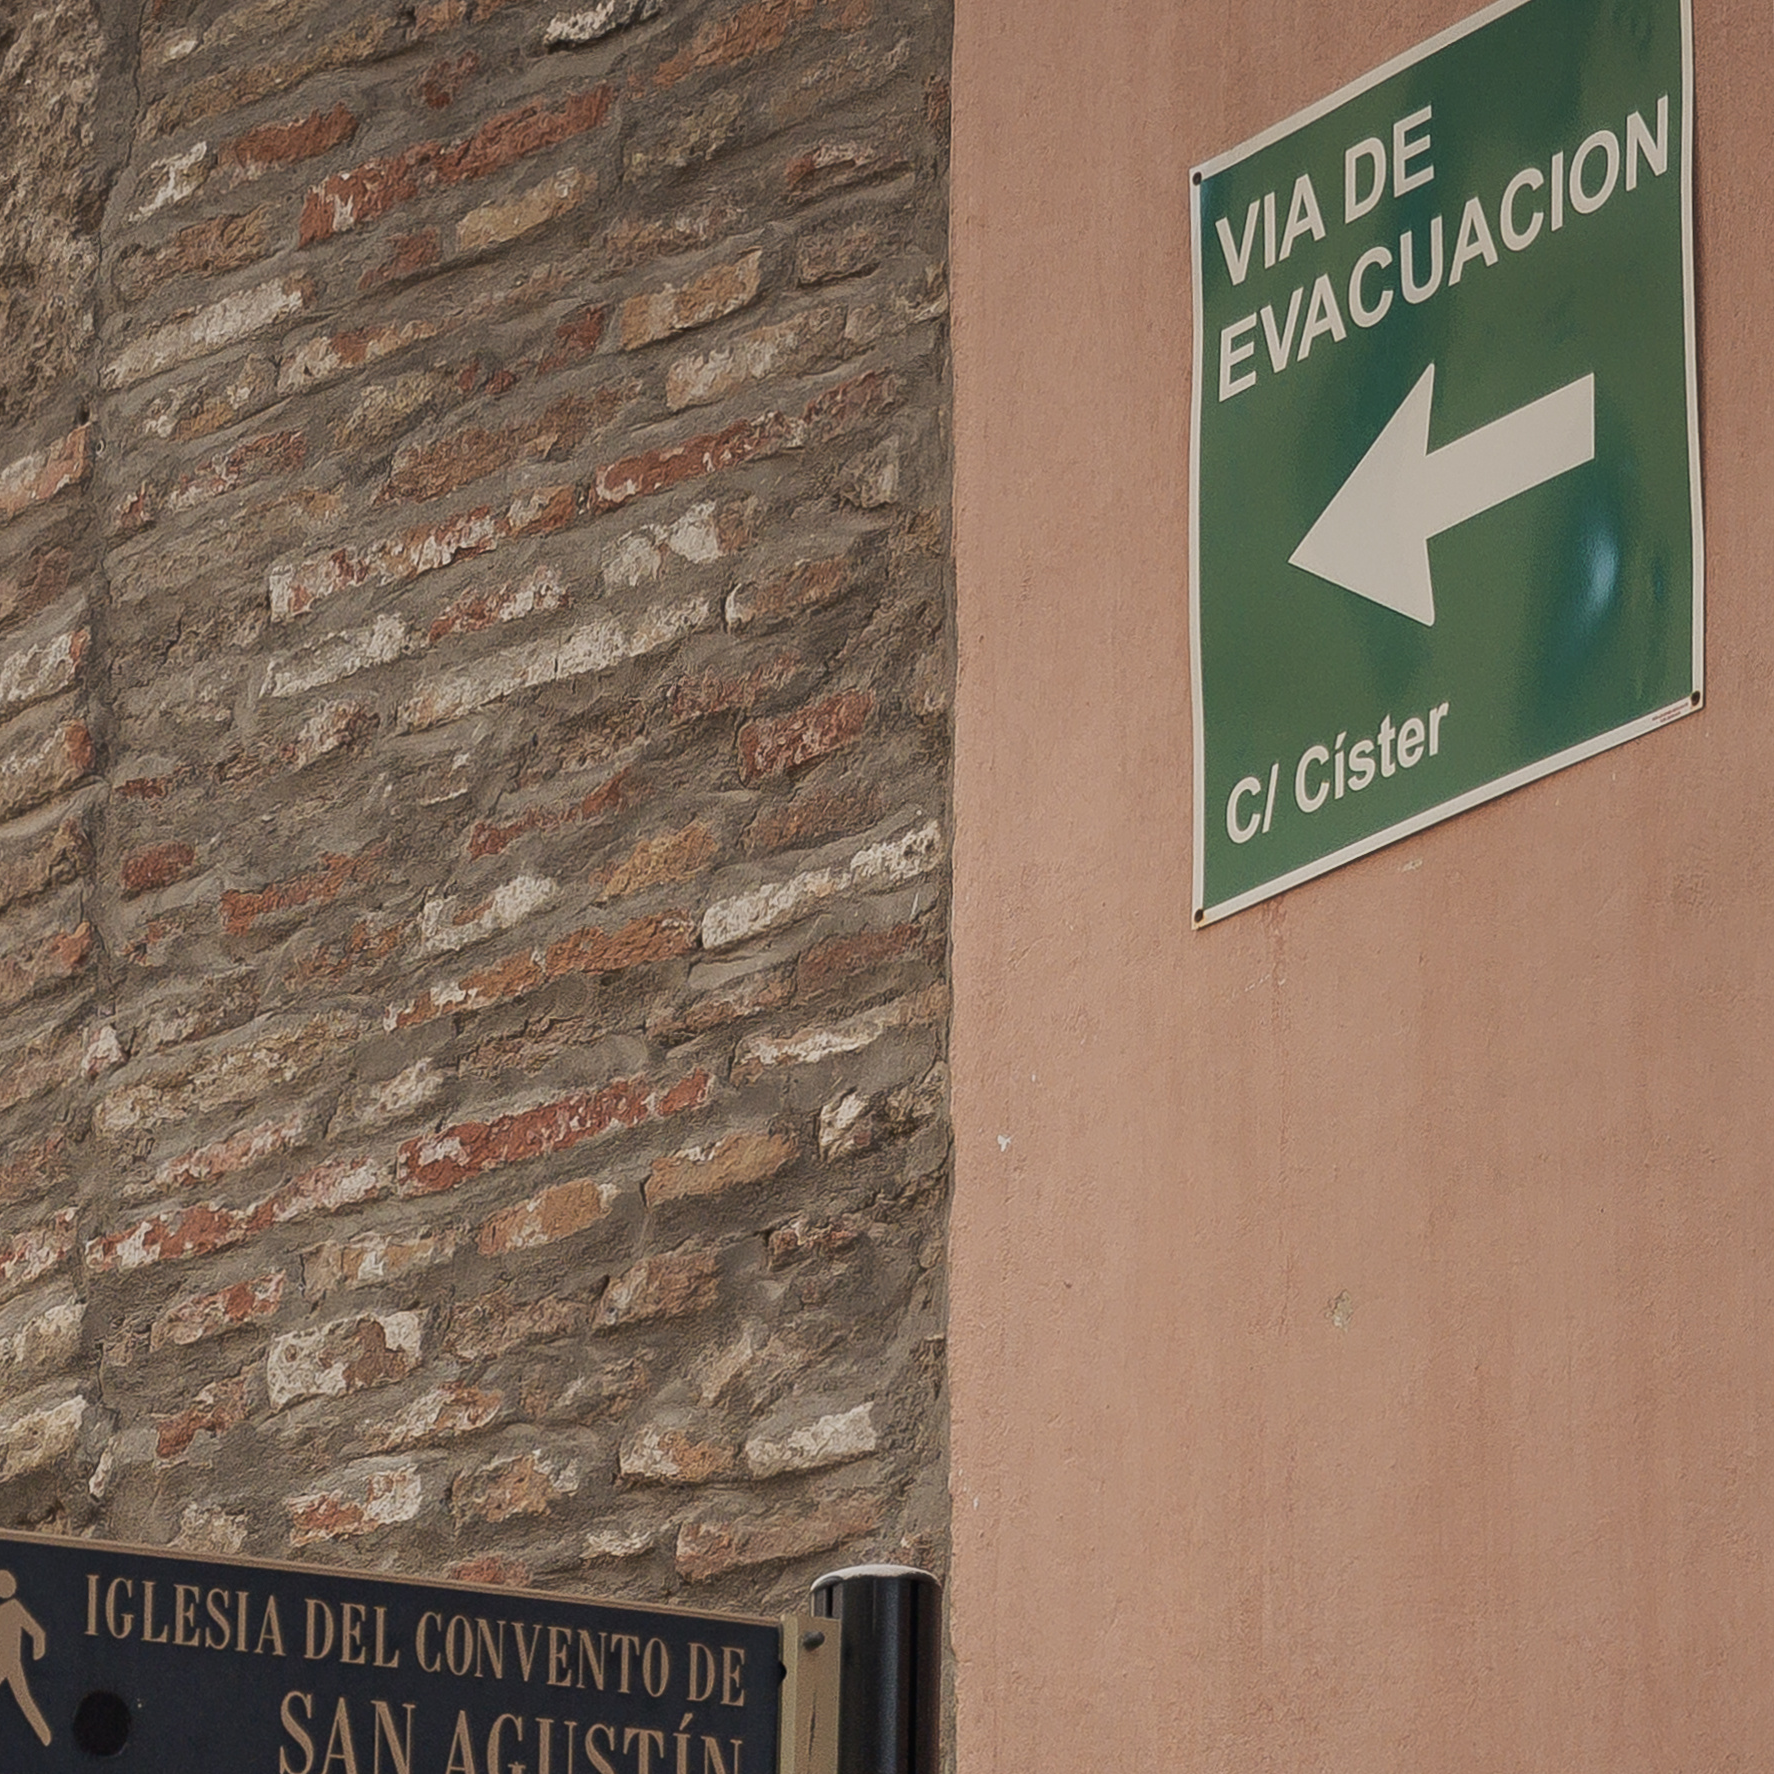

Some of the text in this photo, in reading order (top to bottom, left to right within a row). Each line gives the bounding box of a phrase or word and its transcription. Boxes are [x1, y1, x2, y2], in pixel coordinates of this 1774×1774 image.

[1216, 106, 1433, 285] VIA DE
[1219, 95, 1668, 401] EVACUACION
[1227, 702, 1449, 843] C/ Císter
[85, 1574, 745, 1706] IGLESIA DEL CONVENTO DE
